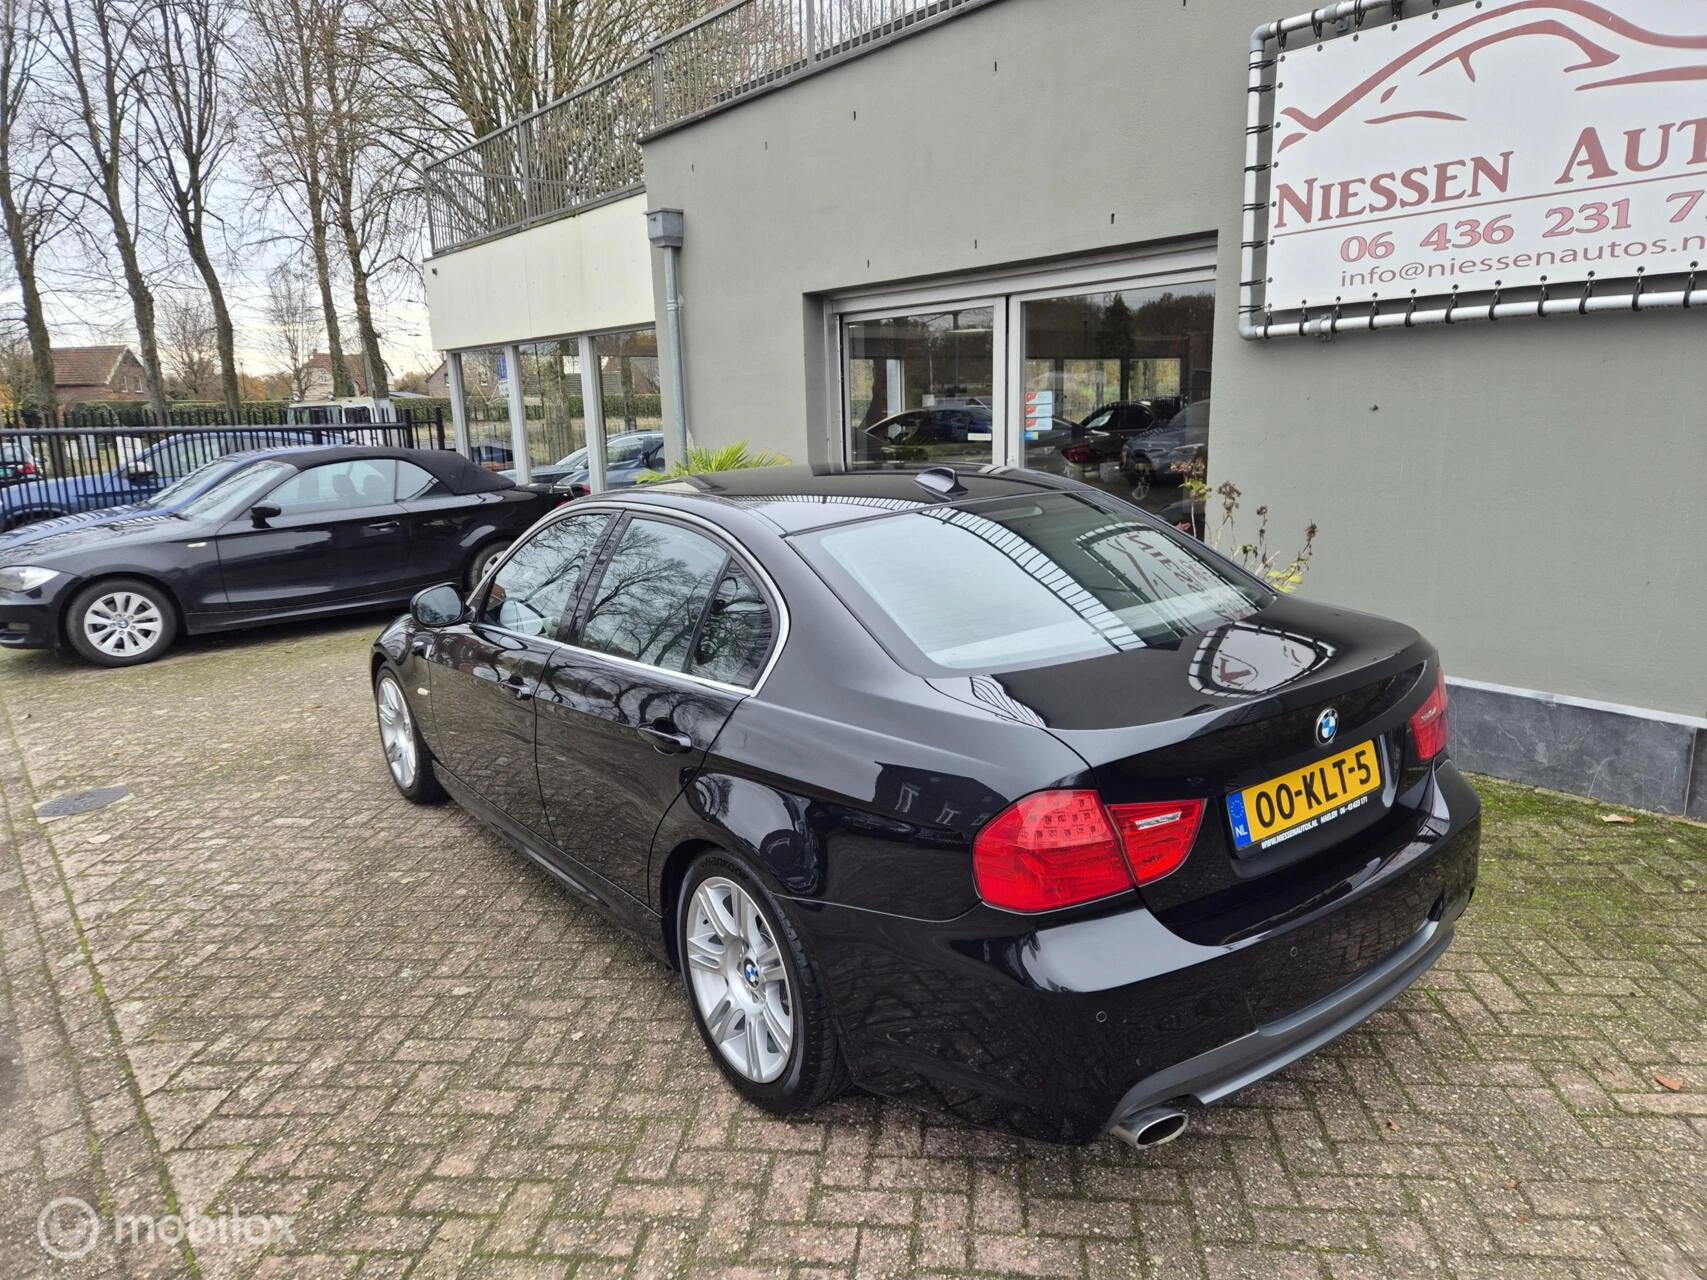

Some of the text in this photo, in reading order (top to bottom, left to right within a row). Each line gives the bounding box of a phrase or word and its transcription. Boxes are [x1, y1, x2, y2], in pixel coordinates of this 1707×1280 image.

[1273, 150, 1515, 229] NIESSEN
[1340, 189, 1707, 263] 06 436 231 7
[1340, 234, 1706, 288] info@niessenautos.n
[1255, 749, 1372, 829] 00-KLT-5
[1235, 824, 1248, 837] NL
